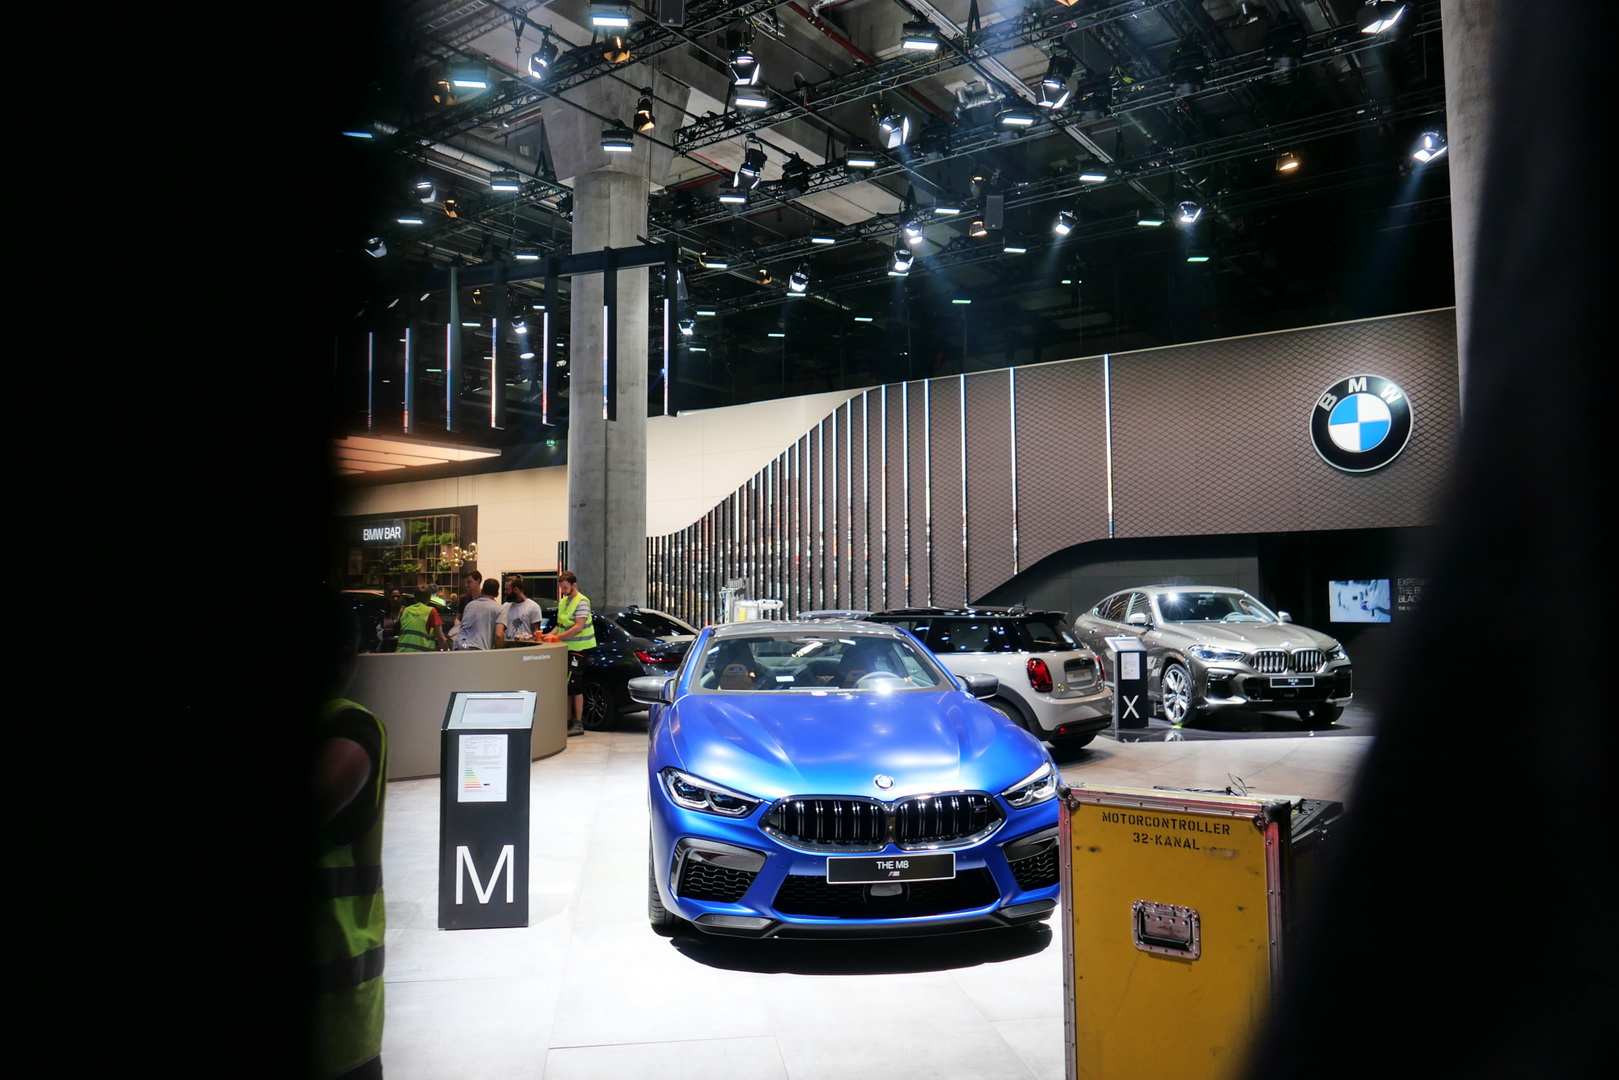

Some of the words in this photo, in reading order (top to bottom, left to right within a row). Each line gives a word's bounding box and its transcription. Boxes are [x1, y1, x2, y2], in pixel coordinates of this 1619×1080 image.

[1318, 376, 1403, 412] BMW
[363, 528, 384, 541] BMW
[384, 526, 402, 540] BAR
[1122, 695, 1140, 719] X
[1102, 811, 1231, 836] MOTORCONTROLLER
[1133, 832, 1200, 851] 32-KANAL
[455, 844, 515, 905] M
[876, 861, 895, 870] THE
[895, 860, 909, 869] M8
